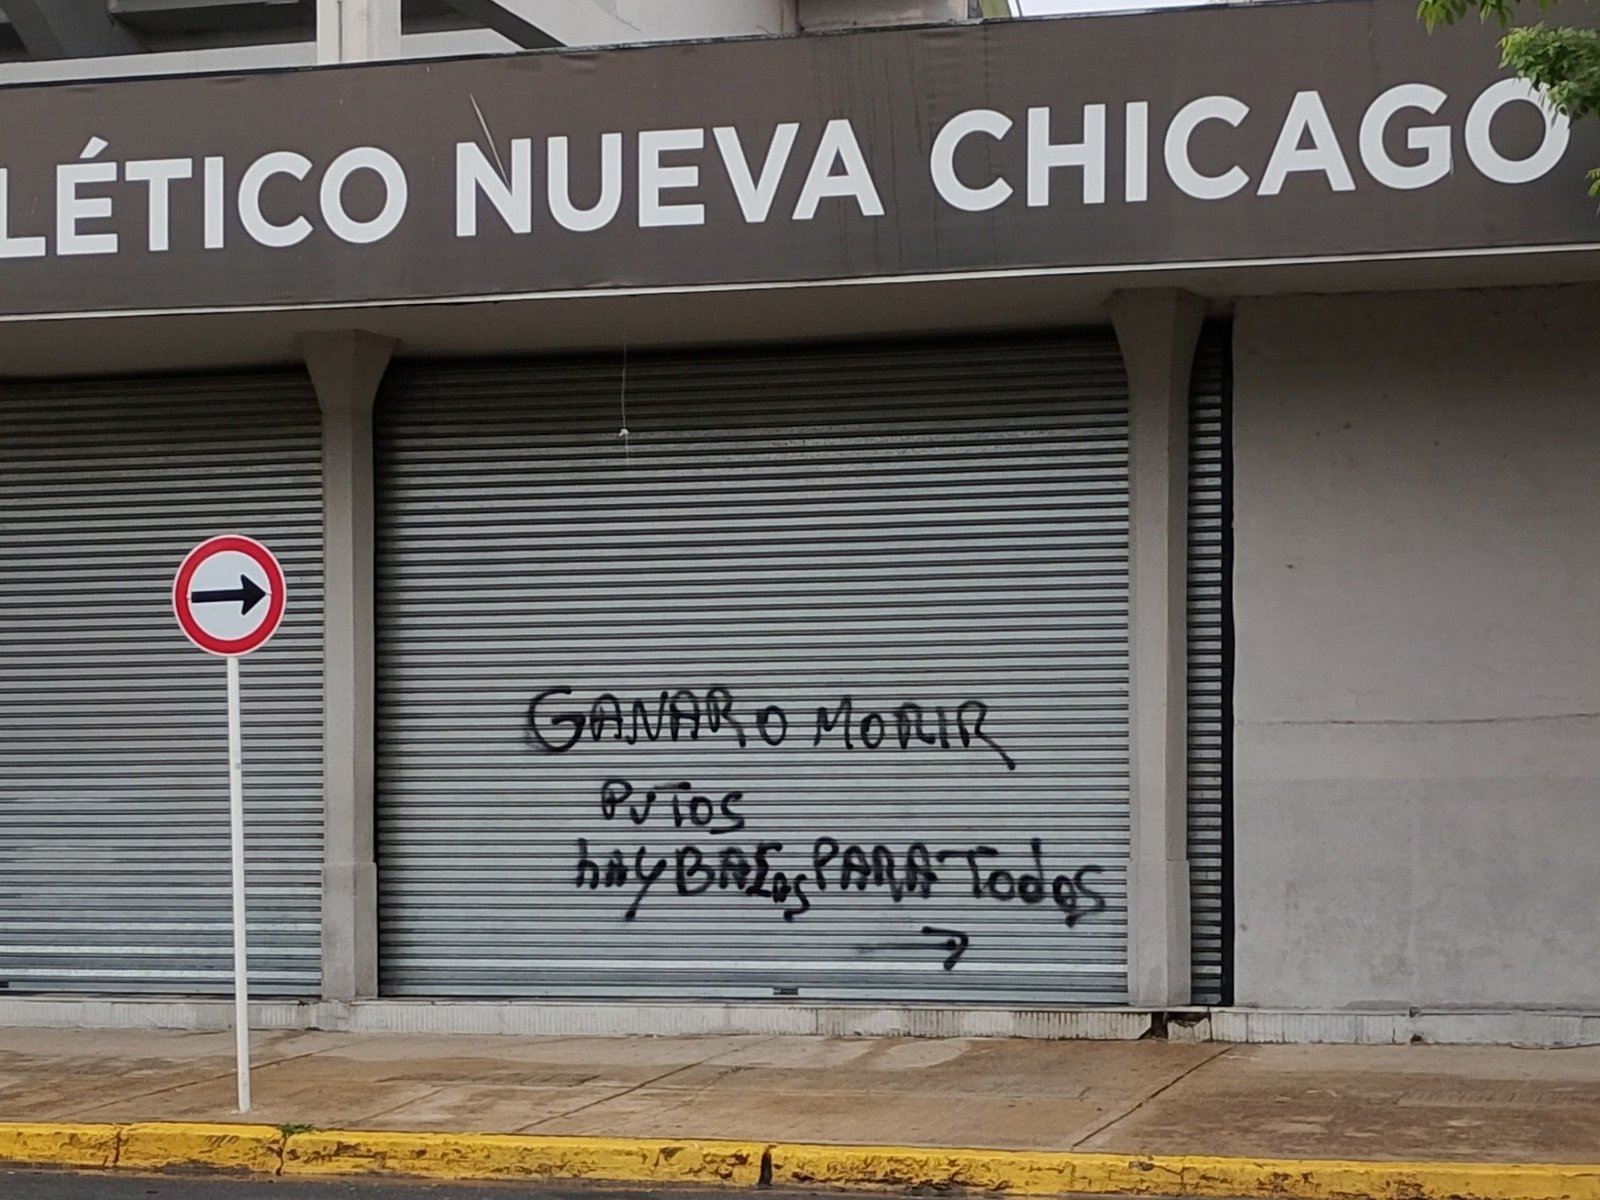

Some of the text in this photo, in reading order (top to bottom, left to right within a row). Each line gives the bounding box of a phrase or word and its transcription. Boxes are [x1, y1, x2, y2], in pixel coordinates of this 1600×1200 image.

[0, 78, 1570, 258] LÉTICO NUEVA CHICAGO
[527, 685, 747, 752] GANAR
[813, 695, 1015, 770] MORIR
[813, 836, 938, 902] PARA
